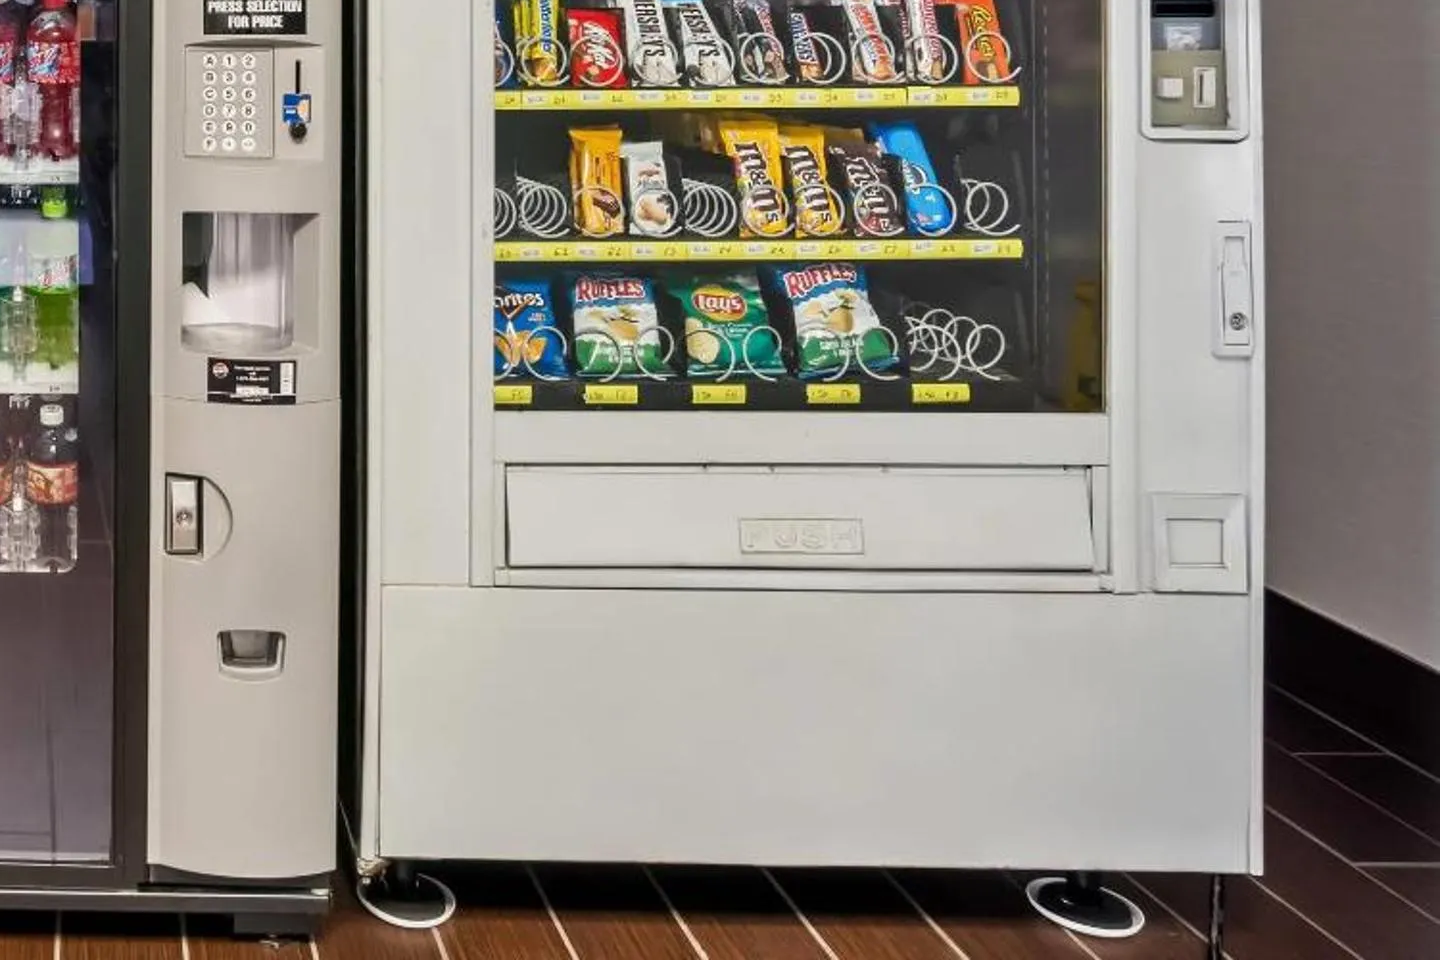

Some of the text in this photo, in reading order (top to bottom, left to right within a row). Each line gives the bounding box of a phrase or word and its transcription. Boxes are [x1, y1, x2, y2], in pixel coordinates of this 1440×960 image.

[208, 0, 302, 13] PRESS SELECTION
[228, 15, 283, 29] FOR PRICE
[575, 278, 645, 301] RUFFLES
[783, 263, 857, 298] RUFFLES
[494, 292, 545, 308] oritos
[698, 292, 742, 313] Lay's
